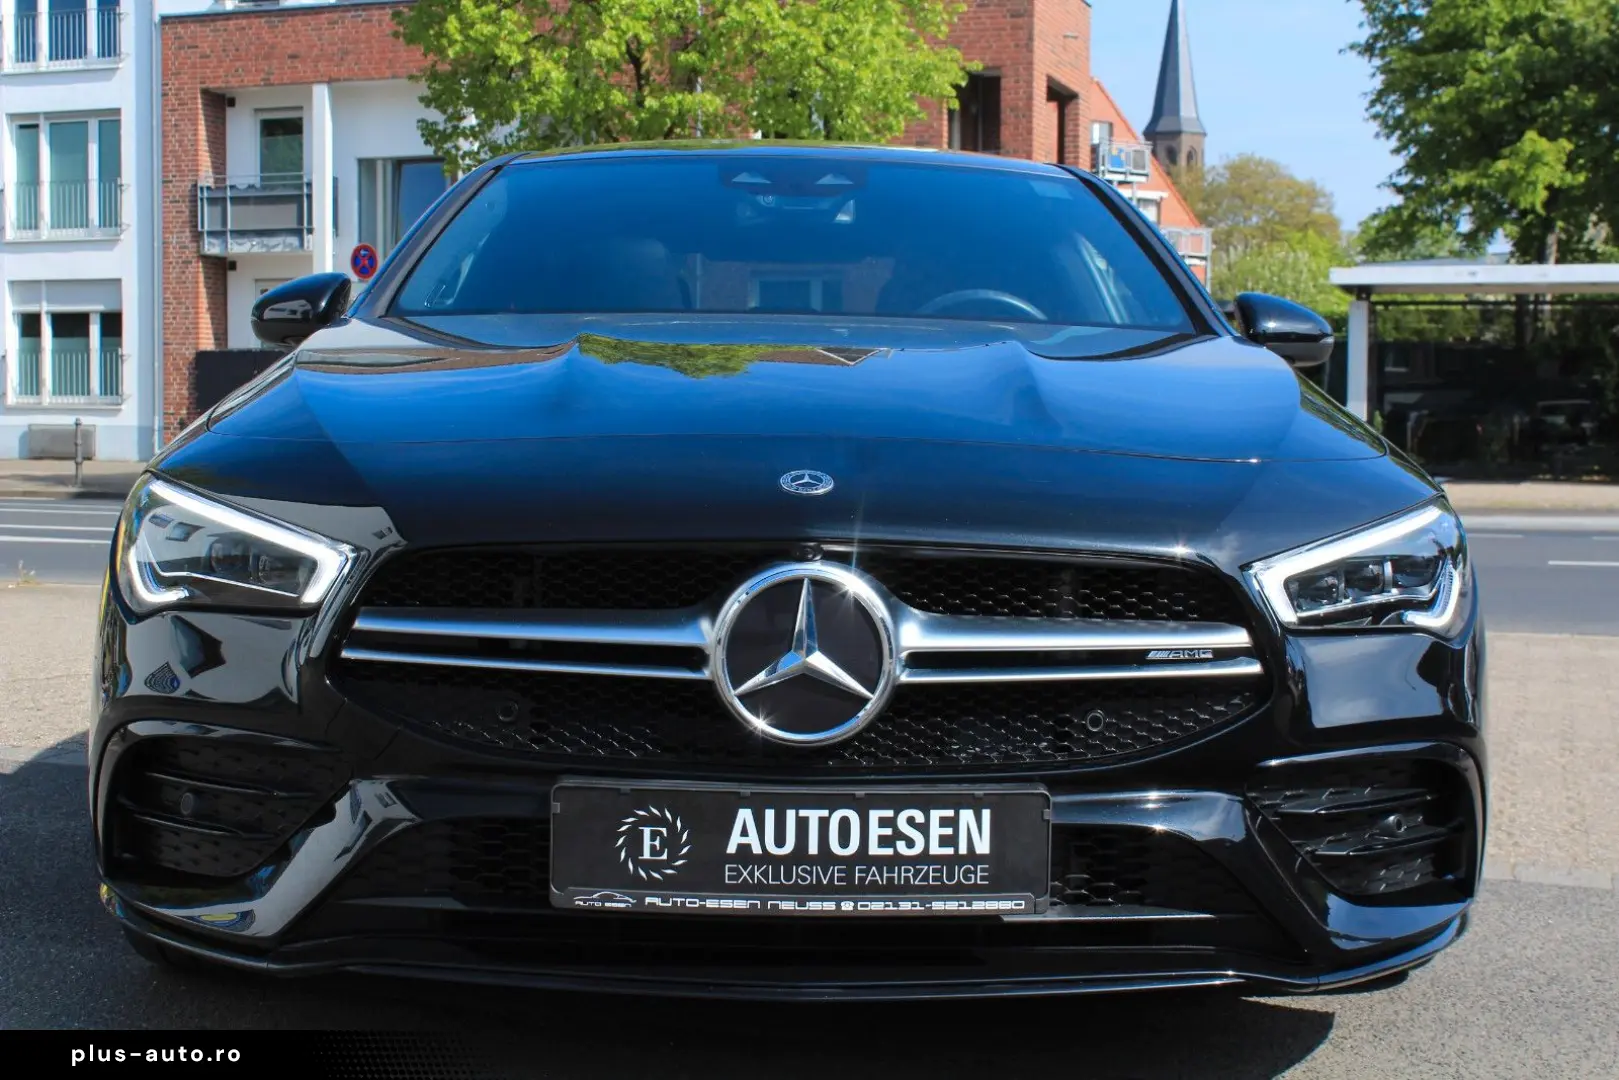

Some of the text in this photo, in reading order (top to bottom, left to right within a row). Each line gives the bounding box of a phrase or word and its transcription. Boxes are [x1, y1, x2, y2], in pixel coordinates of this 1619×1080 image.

[724, 864, 990, 885] EXKLUSIVE FAHRZEUGE
[767, 900, 836, 910] NEUSS
